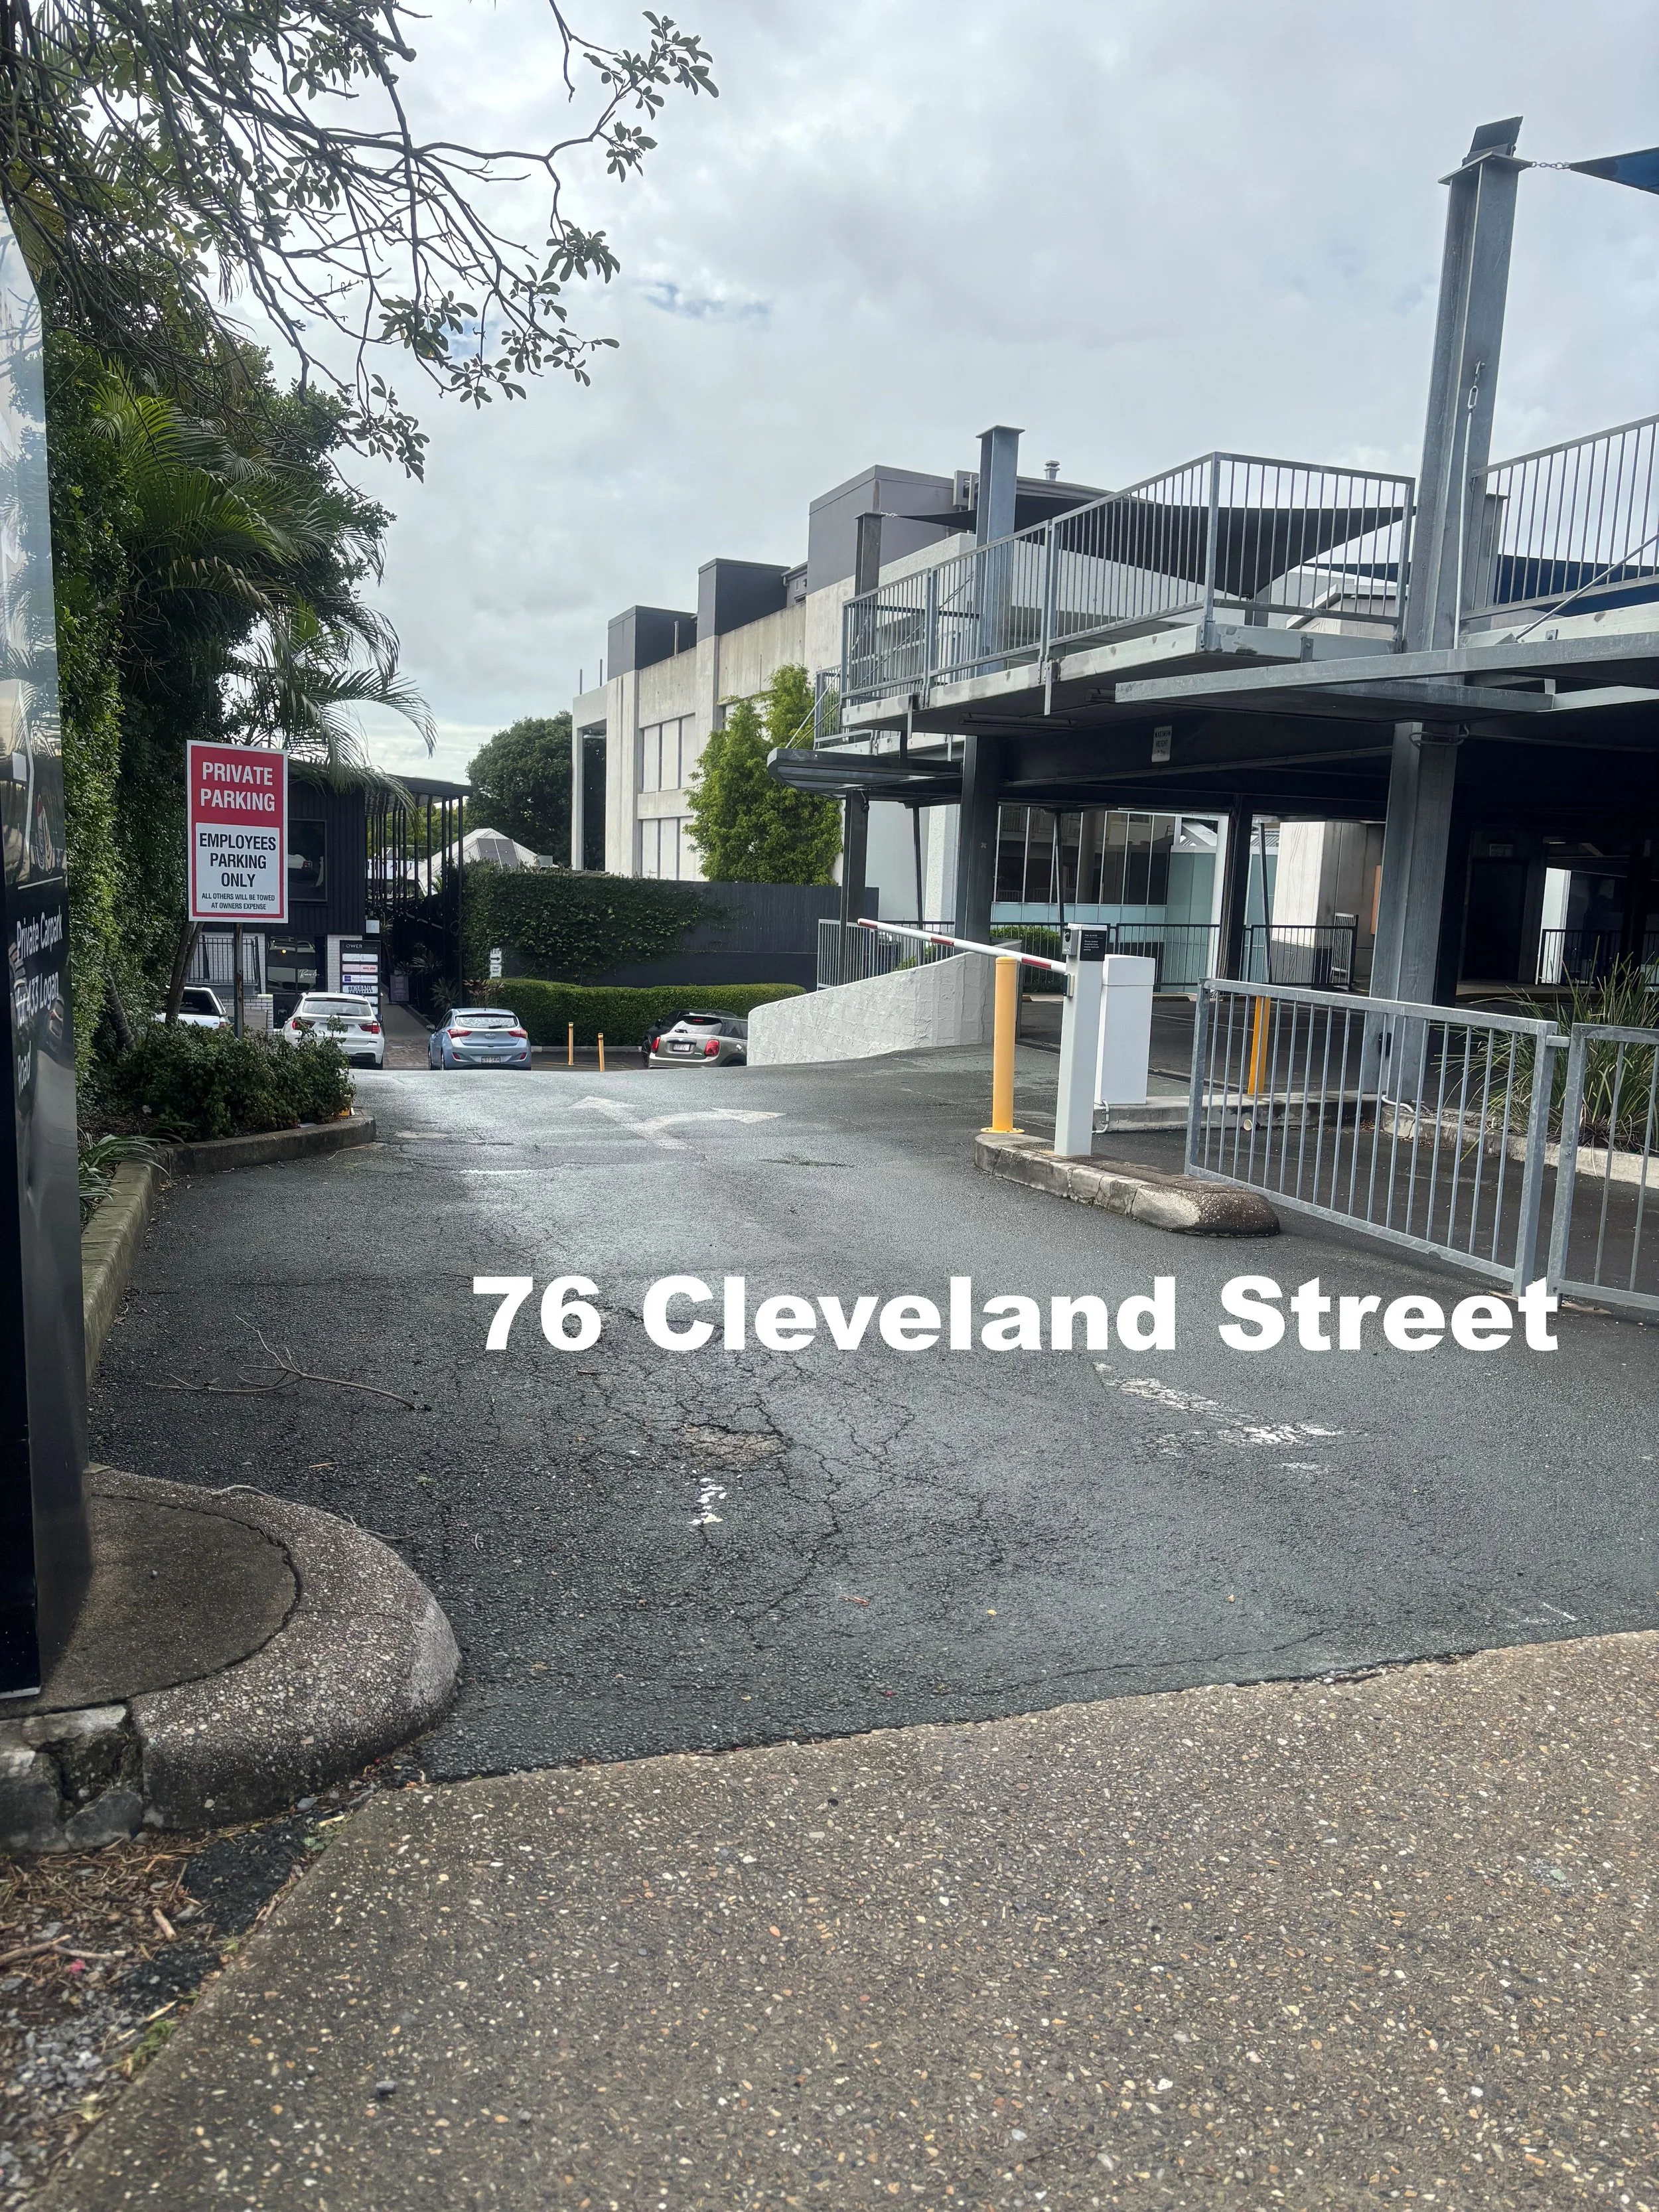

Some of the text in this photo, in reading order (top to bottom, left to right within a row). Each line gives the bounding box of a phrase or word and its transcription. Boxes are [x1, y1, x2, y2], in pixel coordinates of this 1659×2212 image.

[202, 762, 273, 786] PRIVATE
[200, 788, 275, 812] PARKING
[199, 832, 276, 851] EMPLOYEES
[210, 853, 266, 869] PARKING
[221, 872, 255, 888] ONLY
[17, 905, 62, 960] Private Carpark
[27, 975, 39, 1018] 433
[40, 971, 58, 1011] Logan
[18, 1040, 31, 1096] Road
